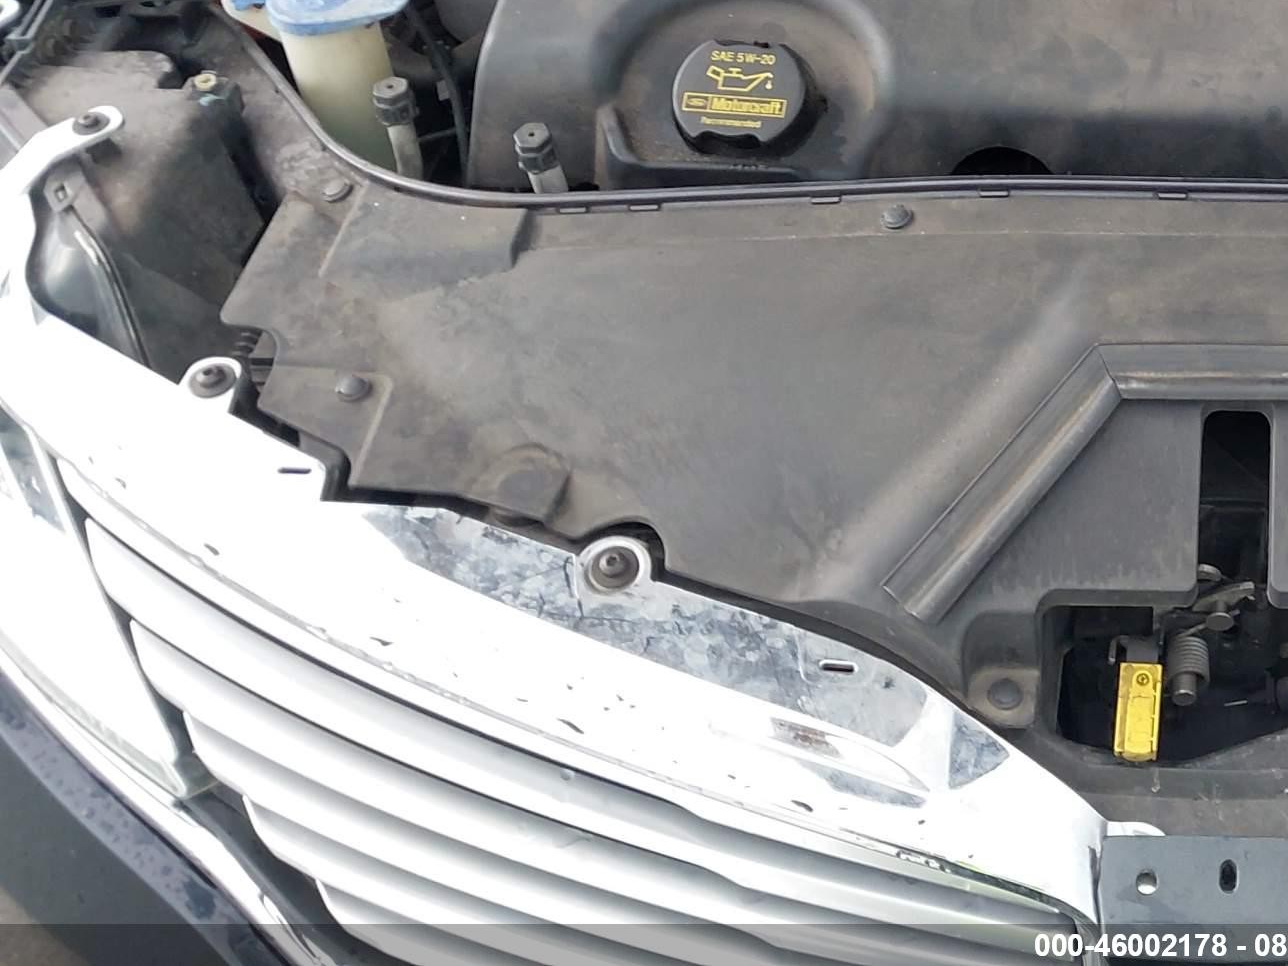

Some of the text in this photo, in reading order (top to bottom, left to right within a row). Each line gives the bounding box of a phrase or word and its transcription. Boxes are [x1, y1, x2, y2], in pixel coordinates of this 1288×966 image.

[711, 50, 776, 65] SAE 5W-20
[711, 96, 782, 115] Motorcraft
